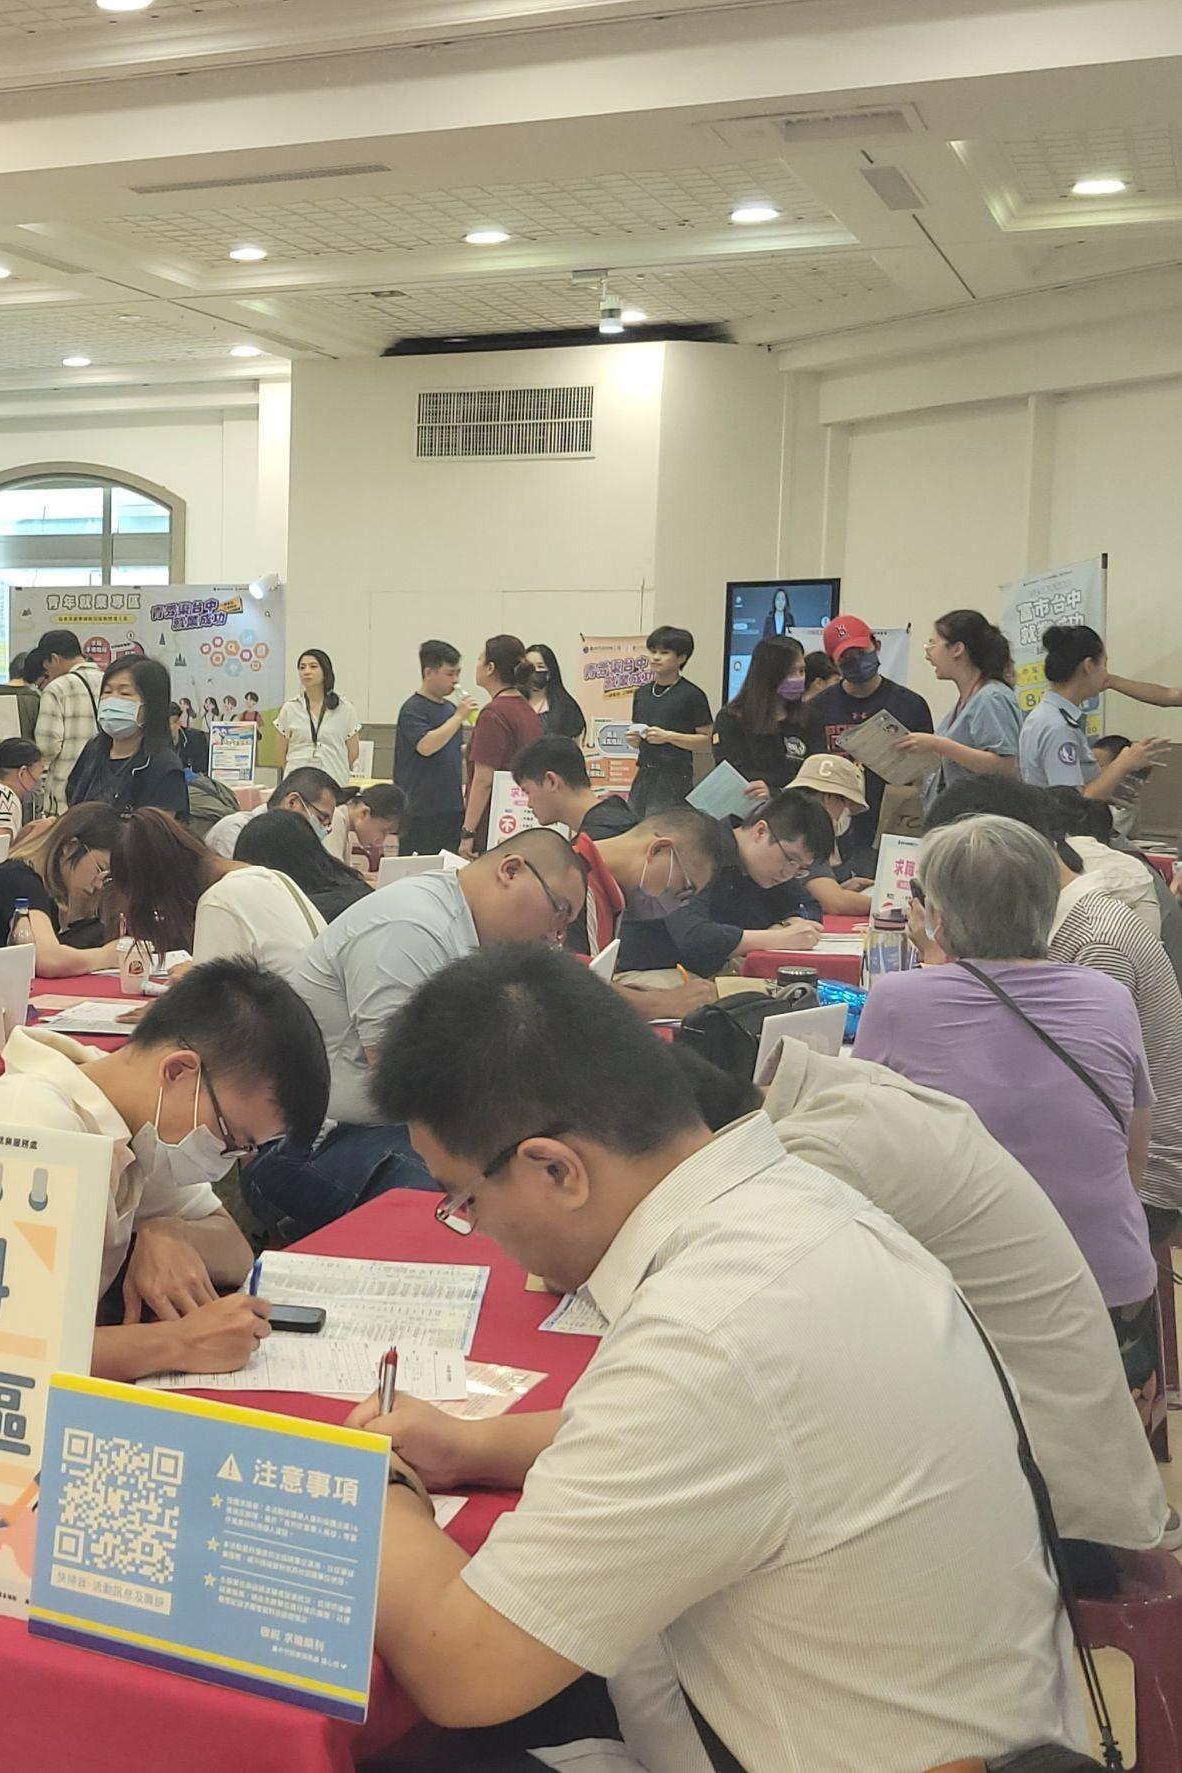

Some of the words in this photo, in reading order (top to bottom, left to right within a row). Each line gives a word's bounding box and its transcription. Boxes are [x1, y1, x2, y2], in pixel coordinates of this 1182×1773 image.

[820, 760, 834, 777] C
[253, 1458, 360, 1507] 注意事項
